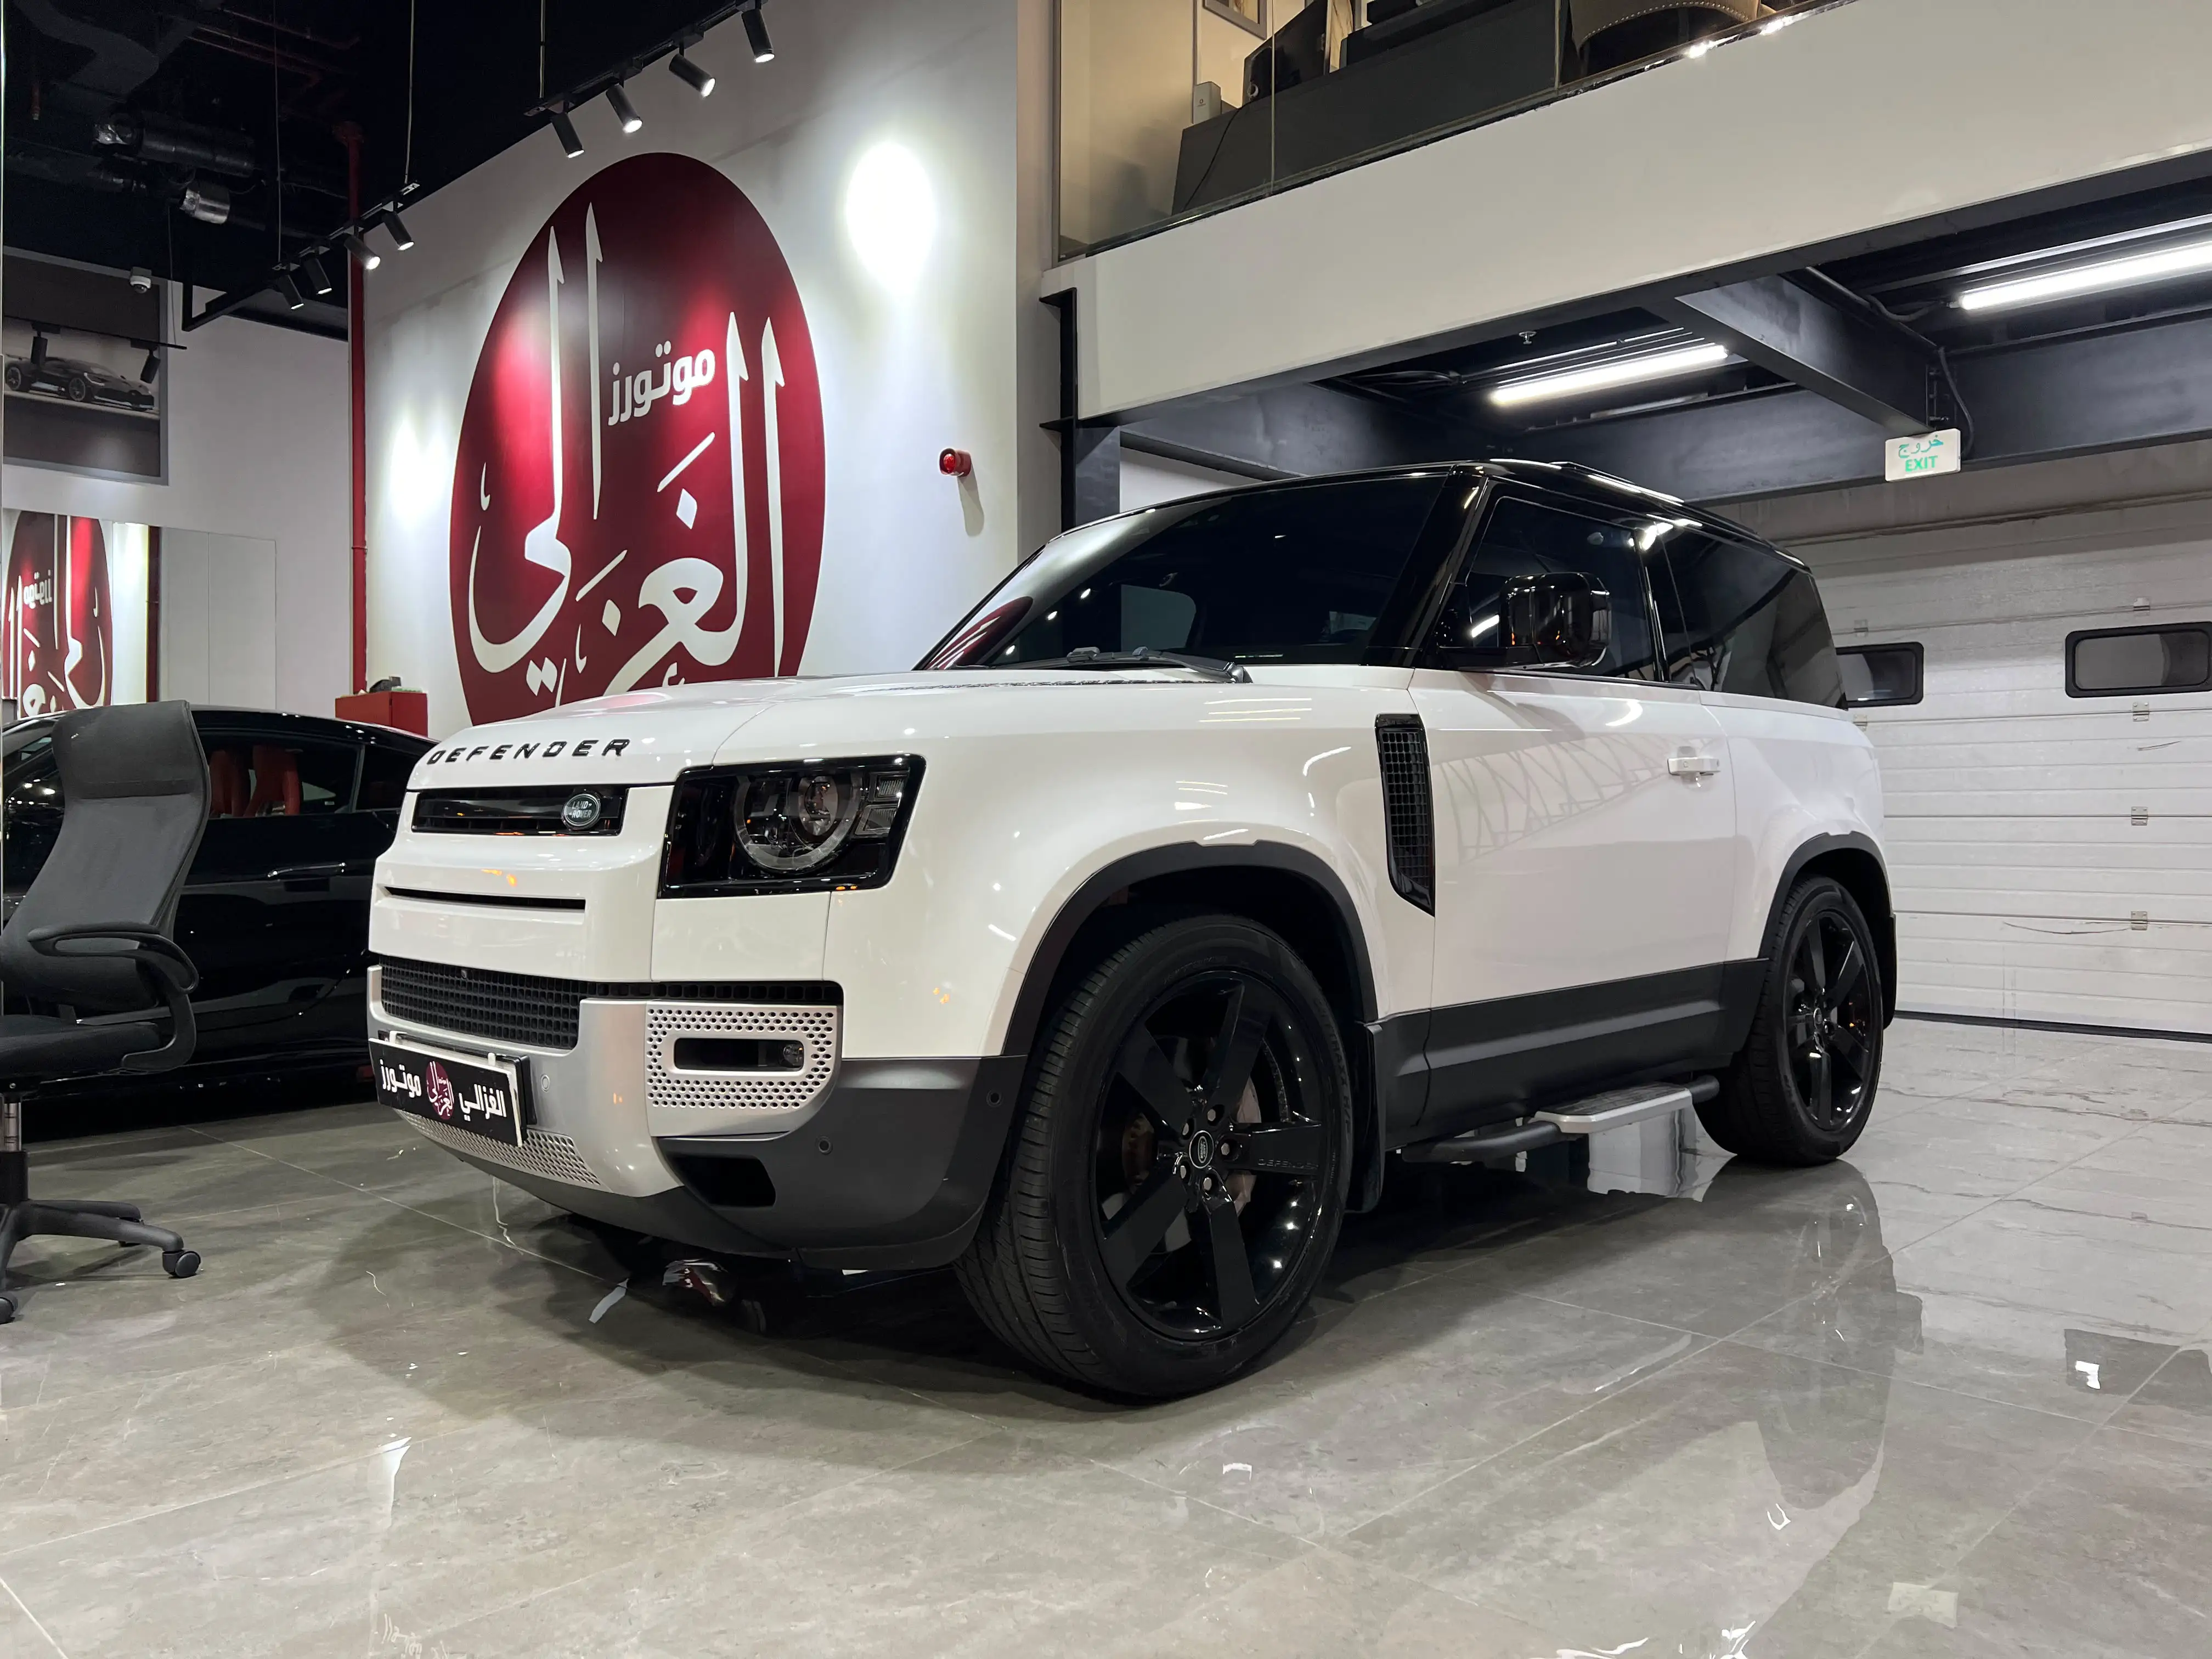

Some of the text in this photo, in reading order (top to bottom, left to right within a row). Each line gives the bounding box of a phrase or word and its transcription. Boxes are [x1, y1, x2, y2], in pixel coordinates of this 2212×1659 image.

[608, 340, 715, 426] موتورز
[1898, 434, 1944, 459] خروج
[1905, 455, 1938, 473] EXIT
[426, 738, 631, 765] DEFENDER
[572, 800, 589, 810] LAND
[572, 809, 592, 819] ROVER
[379, 1059, 507, 1121] الغزالي موتورز
